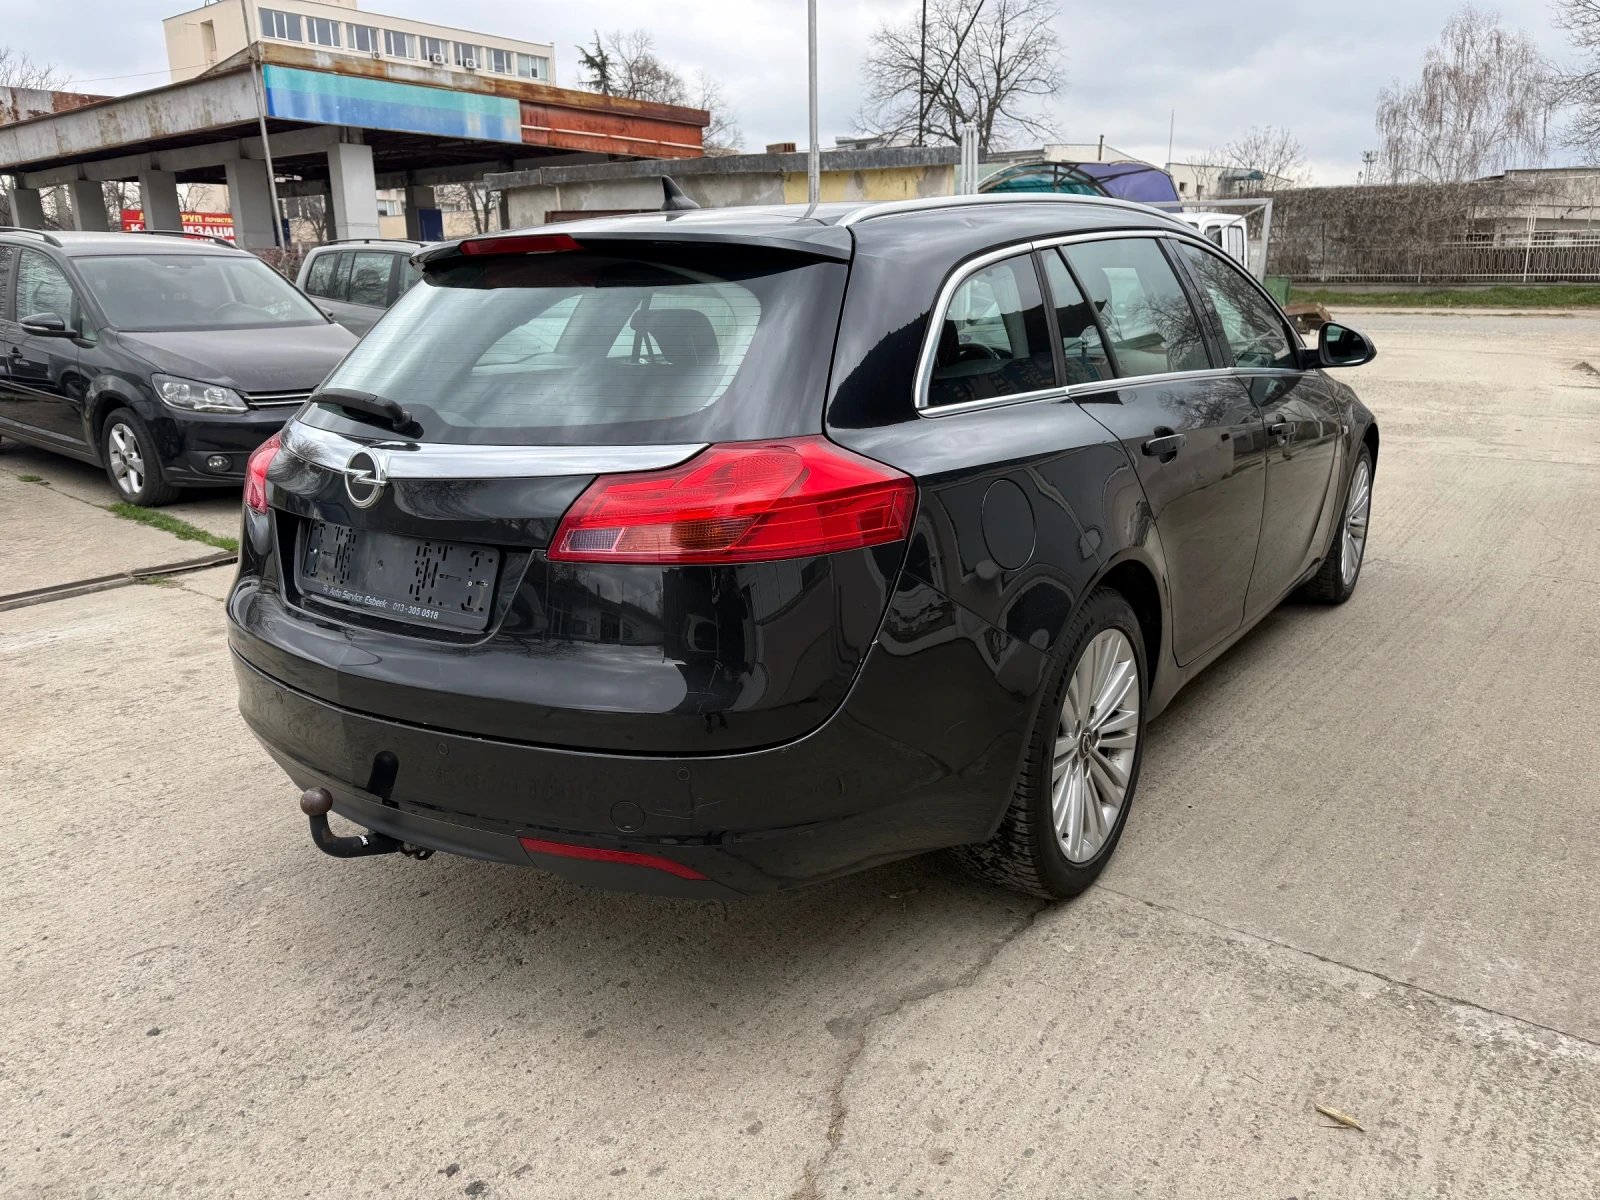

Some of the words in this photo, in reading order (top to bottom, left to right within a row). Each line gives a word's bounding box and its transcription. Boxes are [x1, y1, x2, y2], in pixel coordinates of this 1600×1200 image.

[180, 214, 203, 223] РУП
[183, 225, 234, 237] ИЗАЦИ
[329, 587, 341, 597] Auto
[342, 590, 363, 602] Service
[421, 608, 439, 619] 0518
